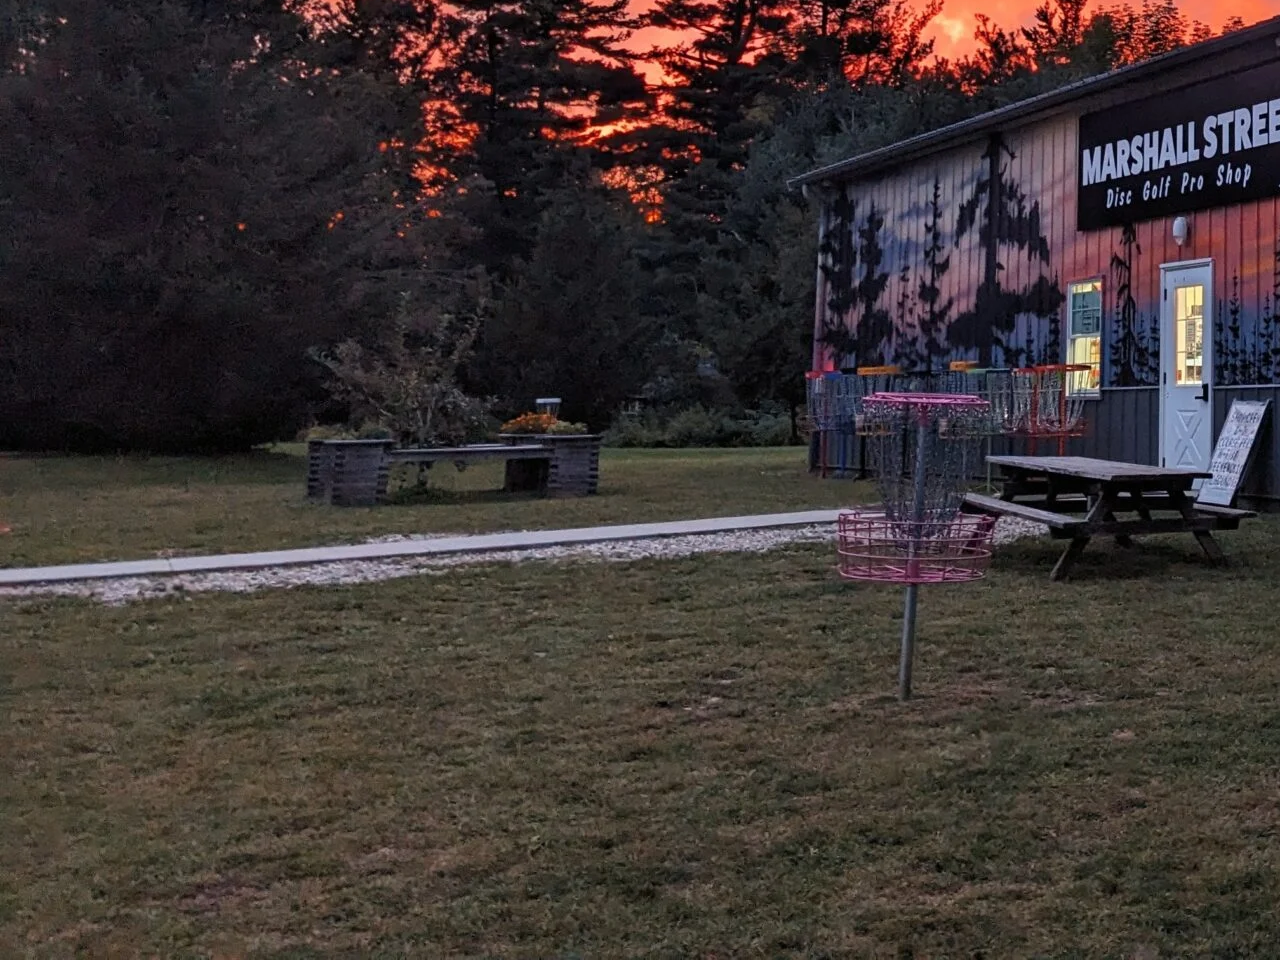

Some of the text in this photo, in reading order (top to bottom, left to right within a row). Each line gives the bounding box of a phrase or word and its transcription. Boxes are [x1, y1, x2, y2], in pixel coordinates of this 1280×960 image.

[1082, 121, 1199, 186] MARSHALL
[1106, 163, 1252, 208] Disc Golf Pro Shop
